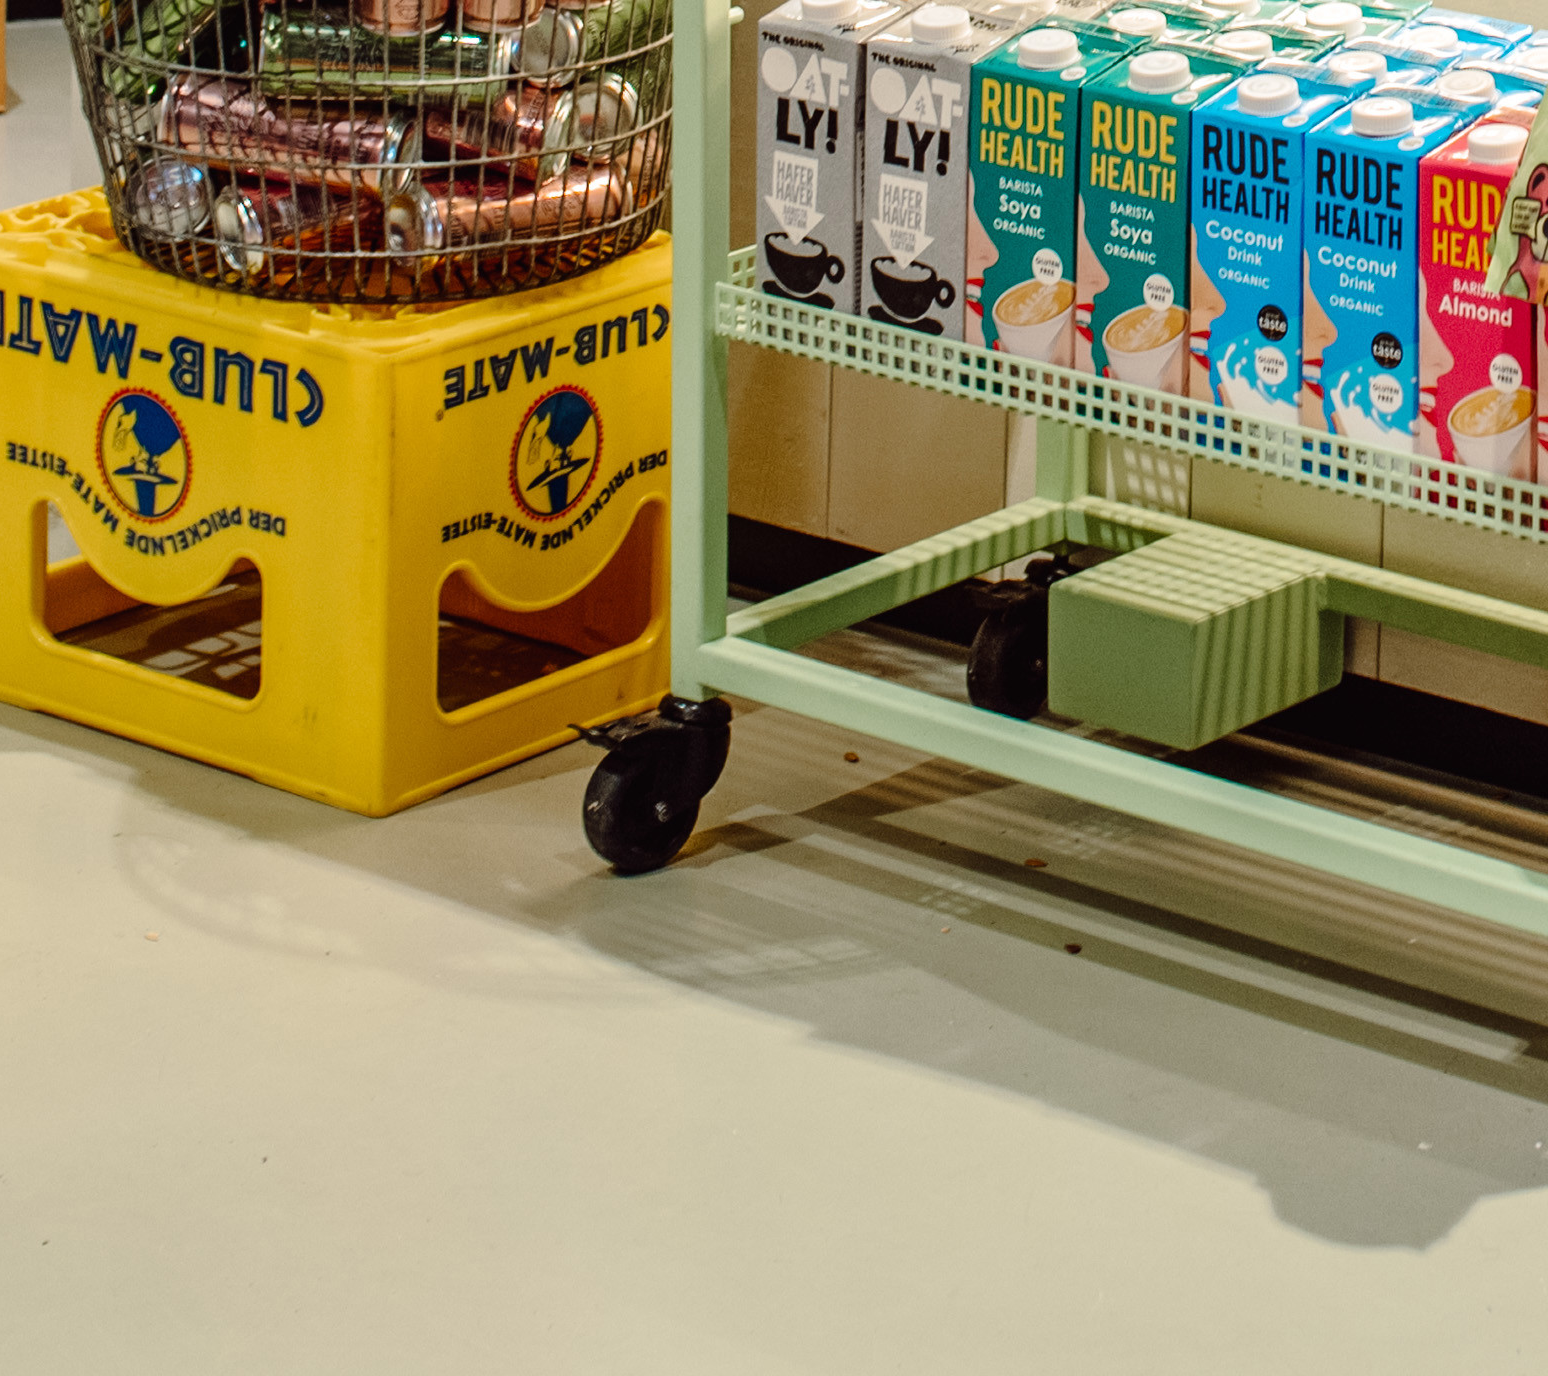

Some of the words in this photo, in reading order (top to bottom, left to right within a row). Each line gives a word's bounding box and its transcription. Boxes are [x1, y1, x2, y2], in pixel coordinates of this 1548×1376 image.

[776, 97, 838, 154] LY!
[981, 77, 1065, 141] RUDE
[979, 129, 1064, 179] HEALTH
[1203, 124, 1289, 184] RUDE
[1316, 148, 1403, 210] RUDE
[999, 195, 1041, 222] Soya
[1202, 173, 1290, 226] HEALTH
[1315, 198, 1403, 252] HEALTH
[1205, 220, 1284, 252] Coconut
[1228, 248, 1262, 269] Drink
[443, 304, 669, 410] CLUB-MATE
